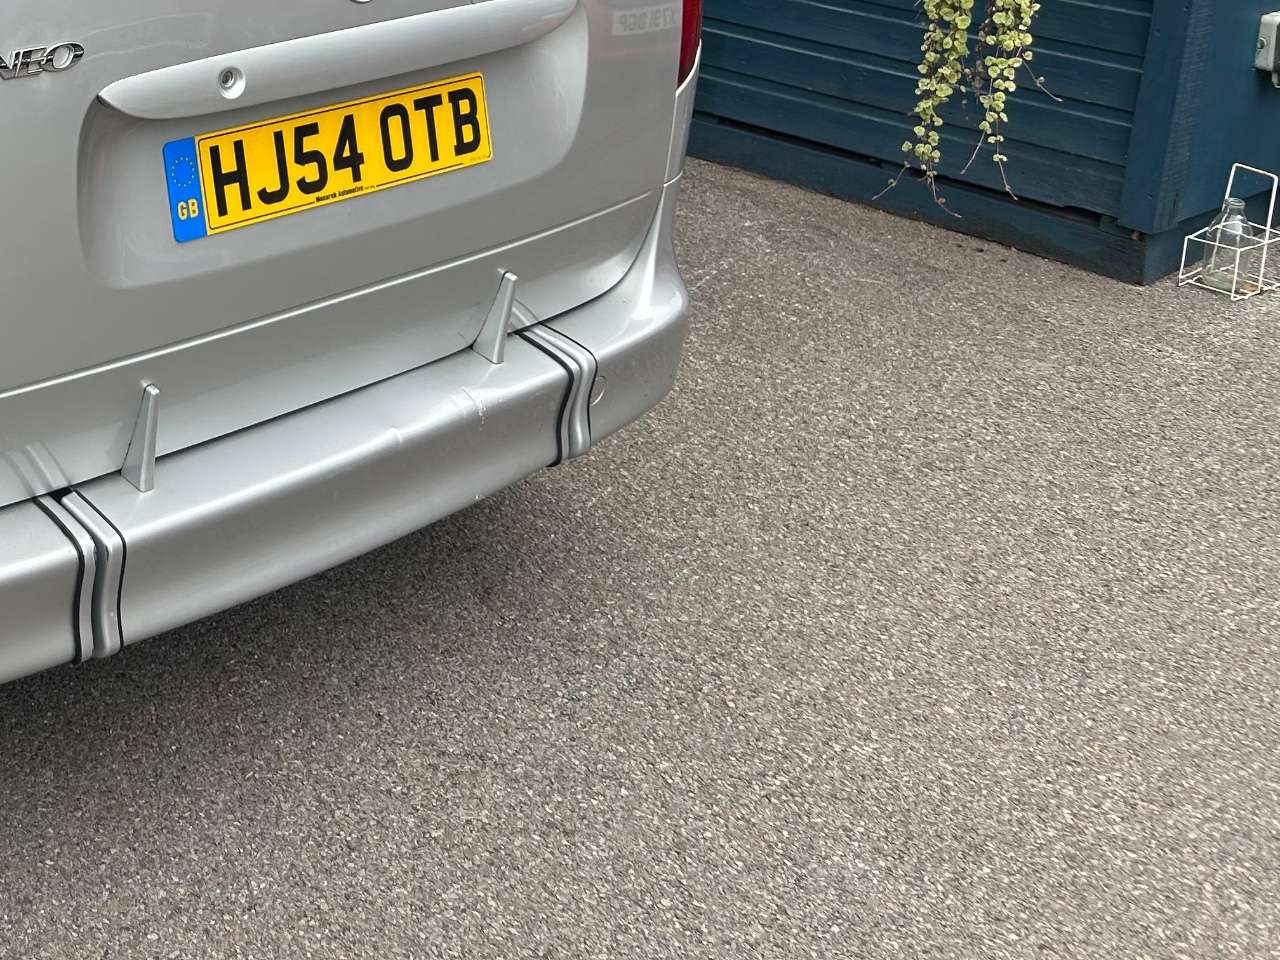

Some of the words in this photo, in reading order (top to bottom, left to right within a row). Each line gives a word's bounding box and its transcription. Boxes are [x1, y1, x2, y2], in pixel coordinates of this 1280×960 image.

[209, 113, 365, 218] HJ54
[379, 86, 482, 173] OTB
[177, 198, 199, 221] GB
